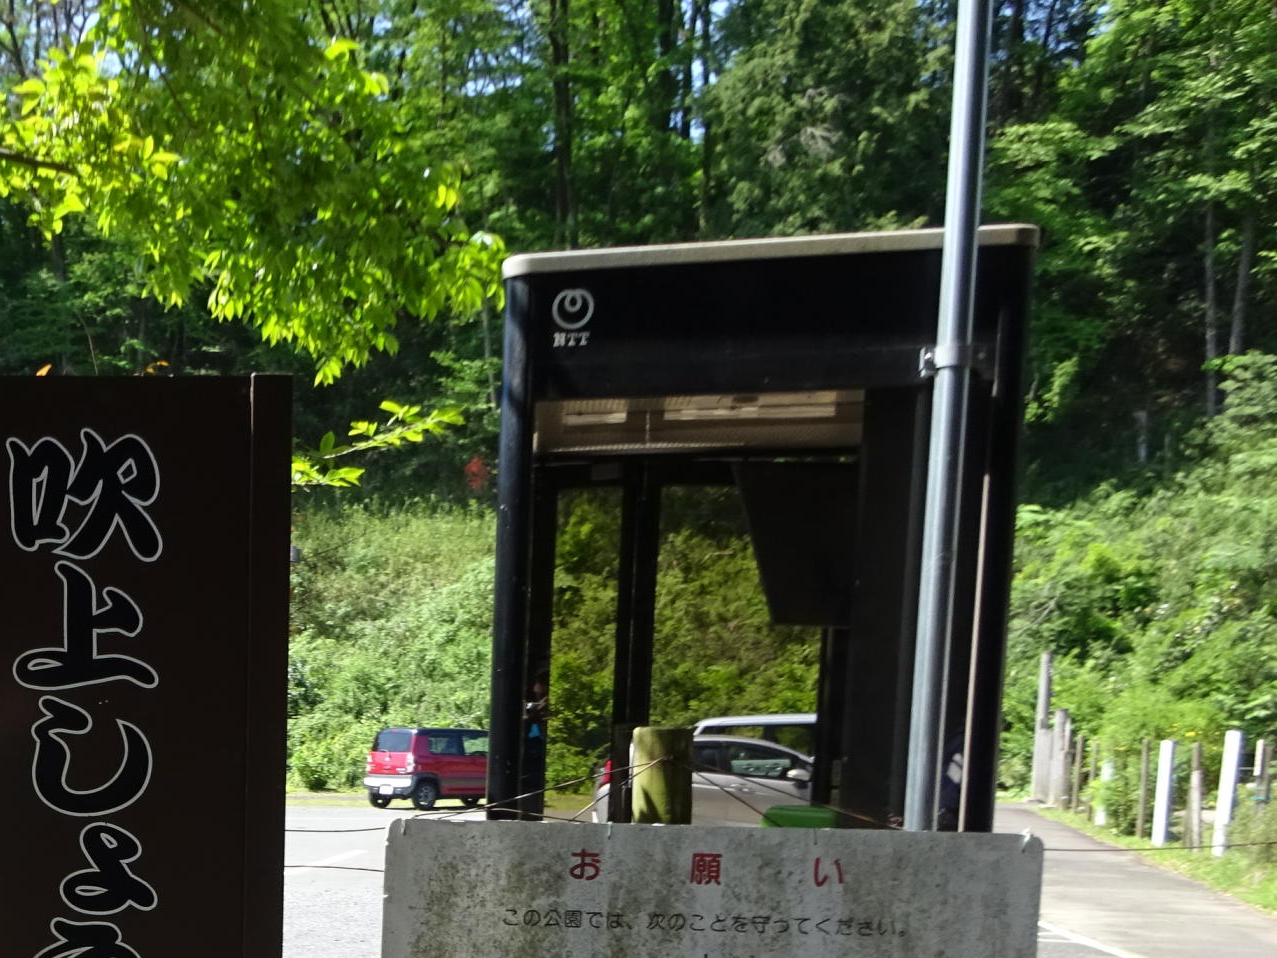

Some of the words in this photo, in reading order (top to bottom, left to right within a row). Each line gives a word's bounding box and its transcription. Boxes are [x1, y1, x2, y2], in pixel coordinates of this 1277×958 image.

[552, 331, 591, 348] NTT
[568, 848, 845, 887] お願い
[502, 908, 907, 938] この公園では、次のことを守ってください。
